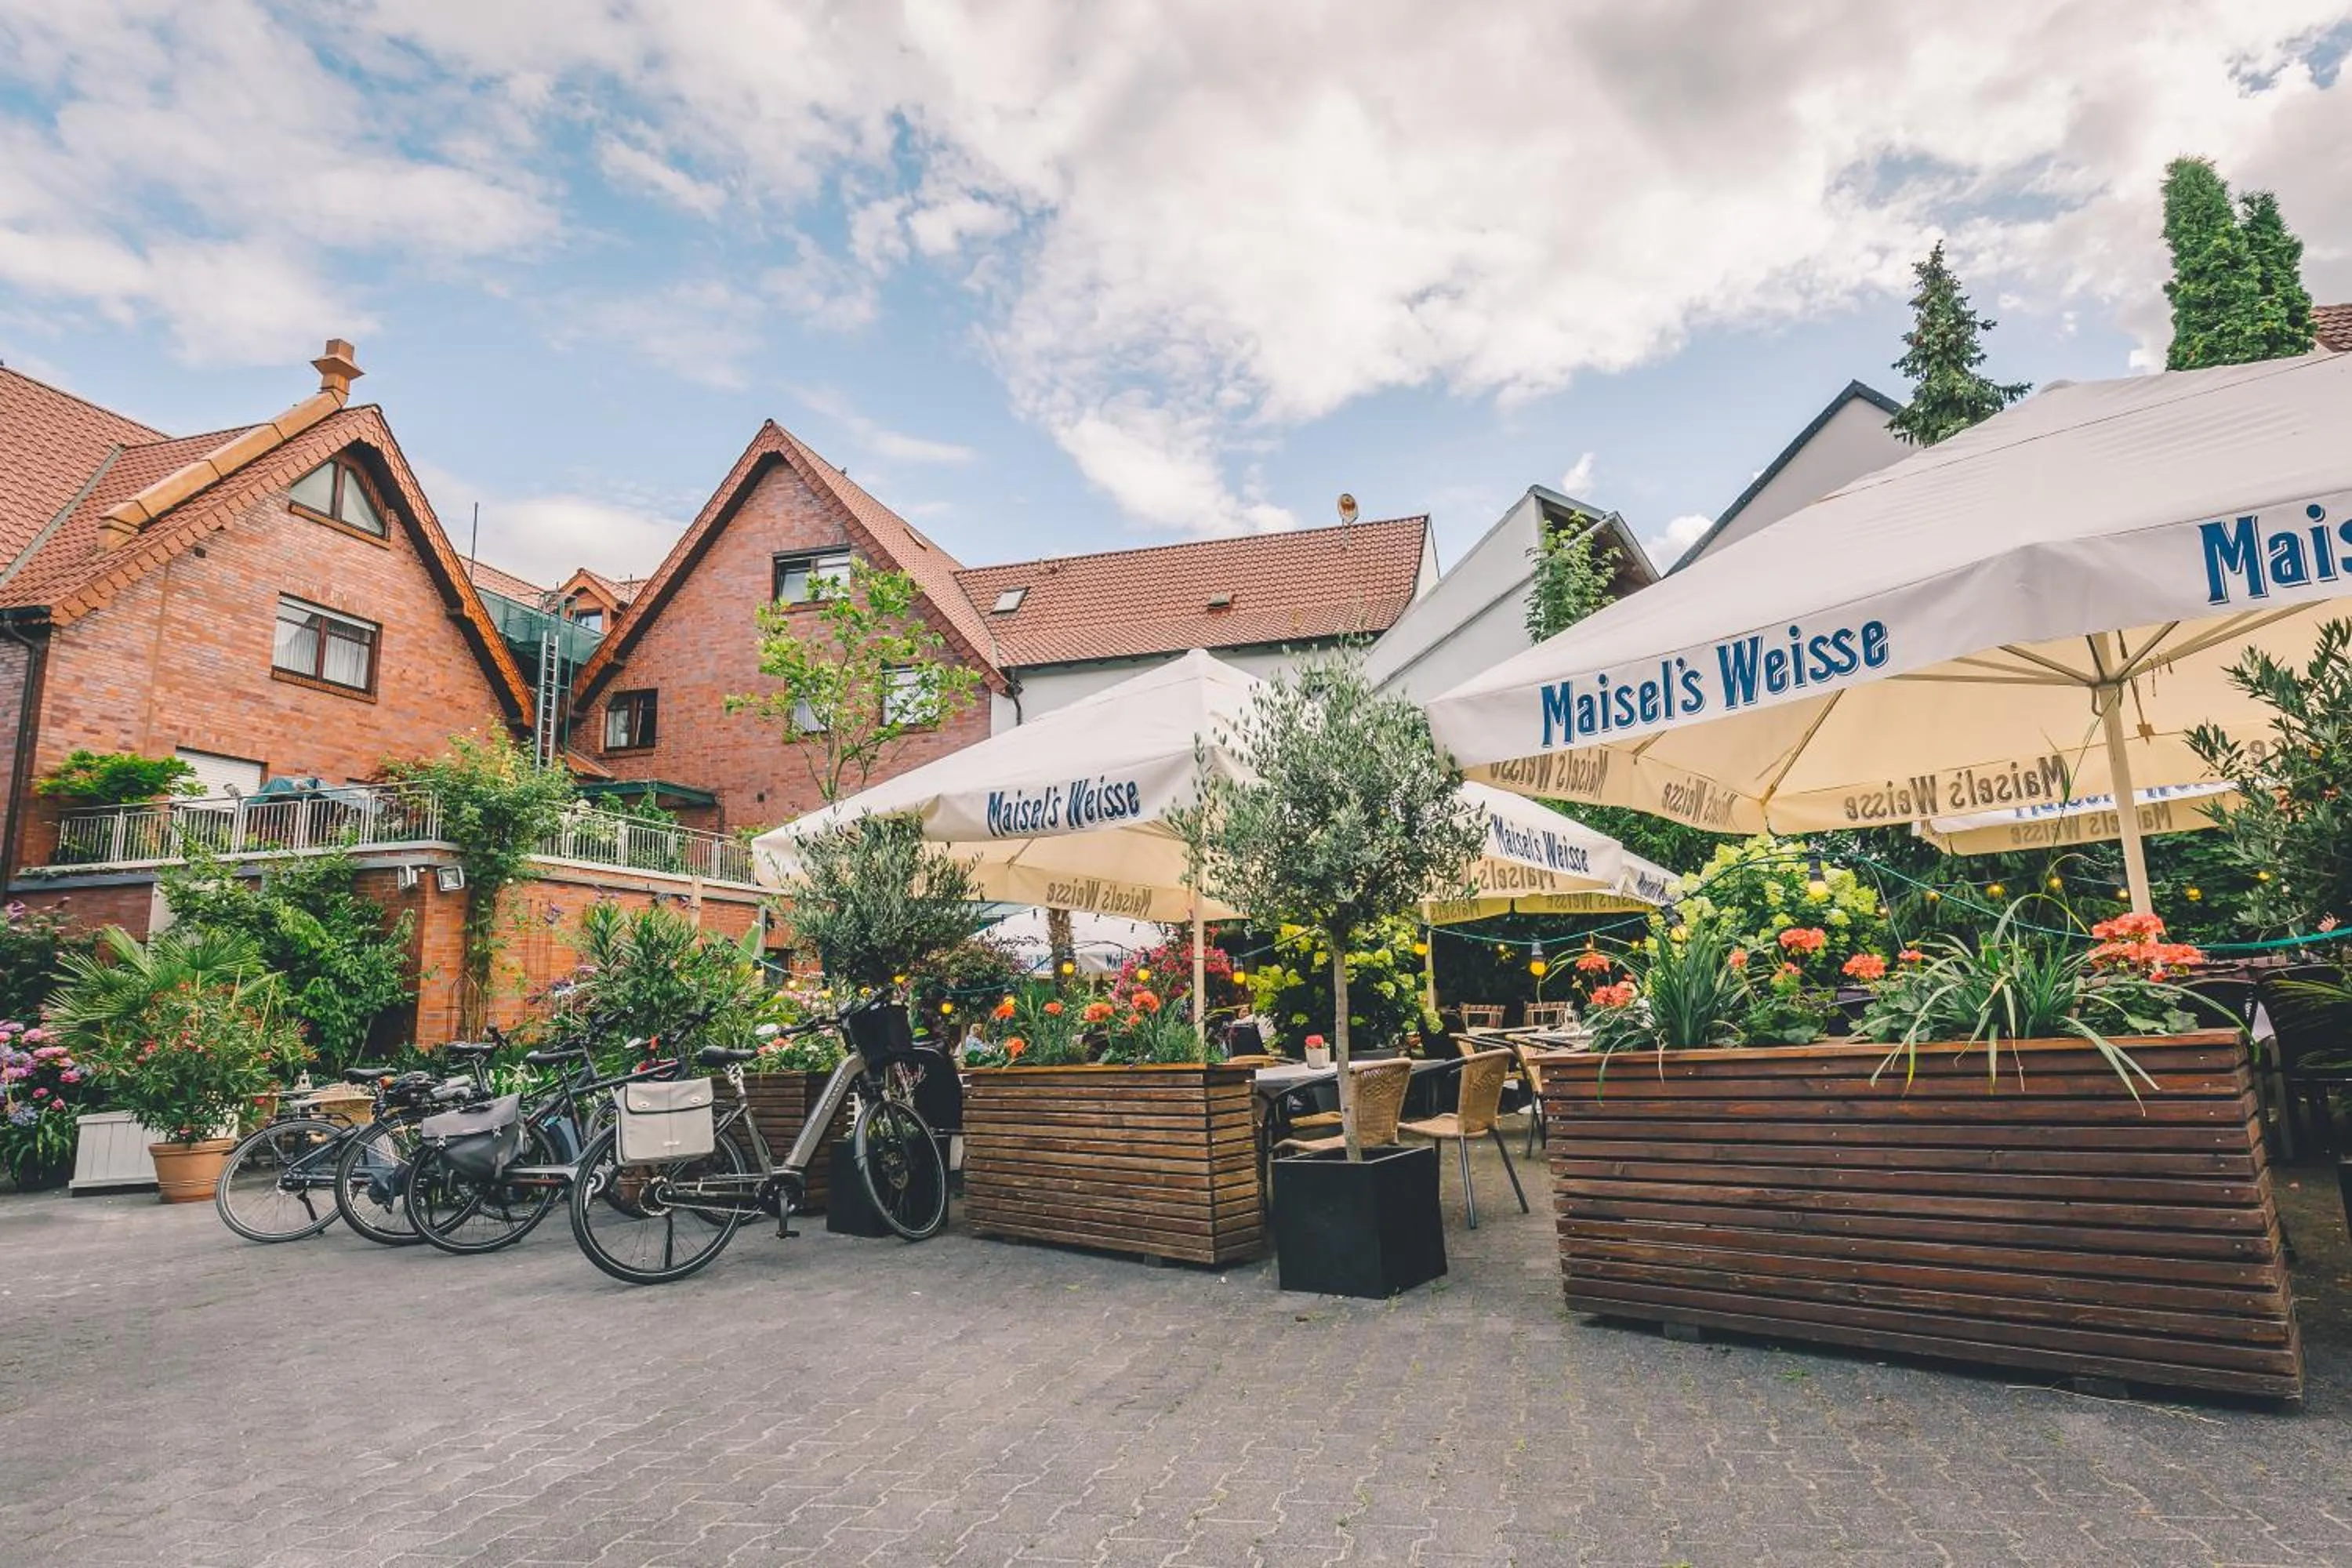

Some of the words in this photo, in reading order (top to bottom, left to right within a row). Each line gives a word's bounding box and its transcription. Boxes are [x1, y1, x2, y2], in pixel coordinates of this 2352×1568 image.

[1541, 657, 1705, 749] Maisel's
[1716, 619, 1889, 711] Weisse
[987, 786, 1061, 837] Maisel's
[1066, 775, 1140, 829] Weisse
[1490, 813, 1542, 863] Maisel's
[1542, 831, 1589, 873] Weisse
